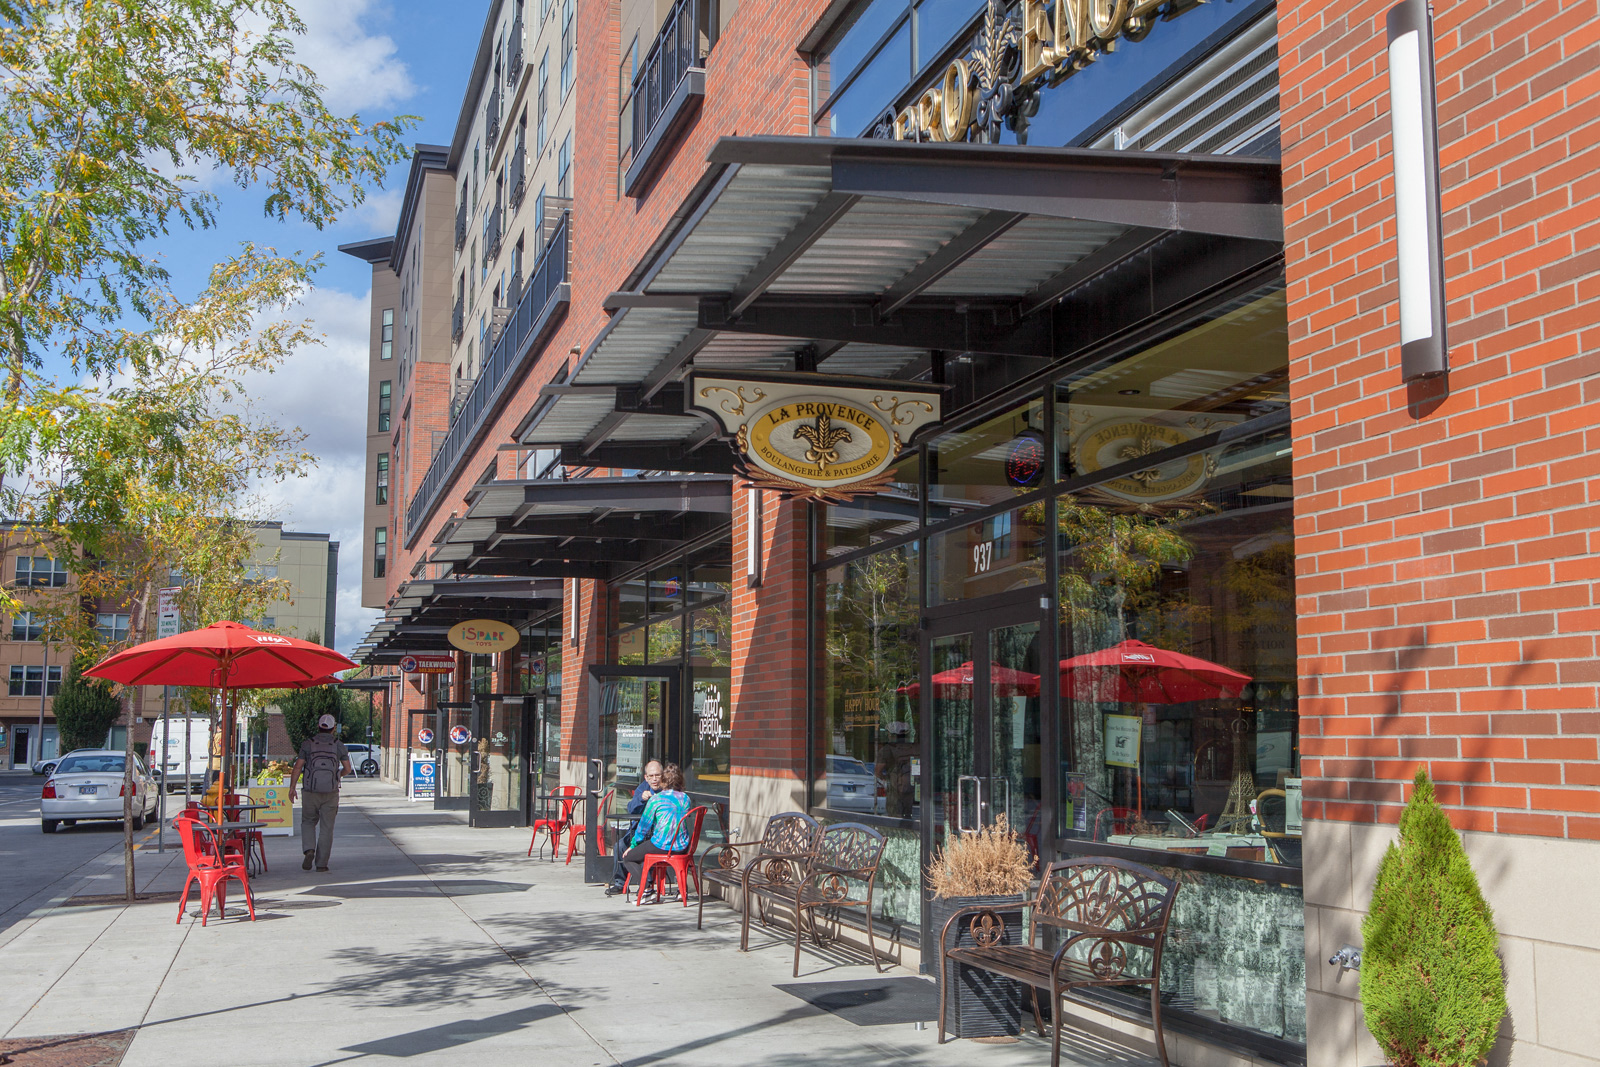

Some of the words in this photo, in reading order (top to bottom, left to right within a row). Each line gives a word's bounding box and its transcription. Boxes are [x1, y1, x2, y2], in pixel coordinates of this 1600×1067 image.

[768, 408, 790, 425] LA
[796, 403, 875, 431] PROVENCE
[761, 446, 823, 477] BOULANGERIE
[834, 454, 880, 477] PATISSERIE
[973, 541, 992, 573] 937
[844, 696, 864, 712] HAPPY
[864, 698, 880, 711] HOUR
[699, 715, 719, 741] gelato
